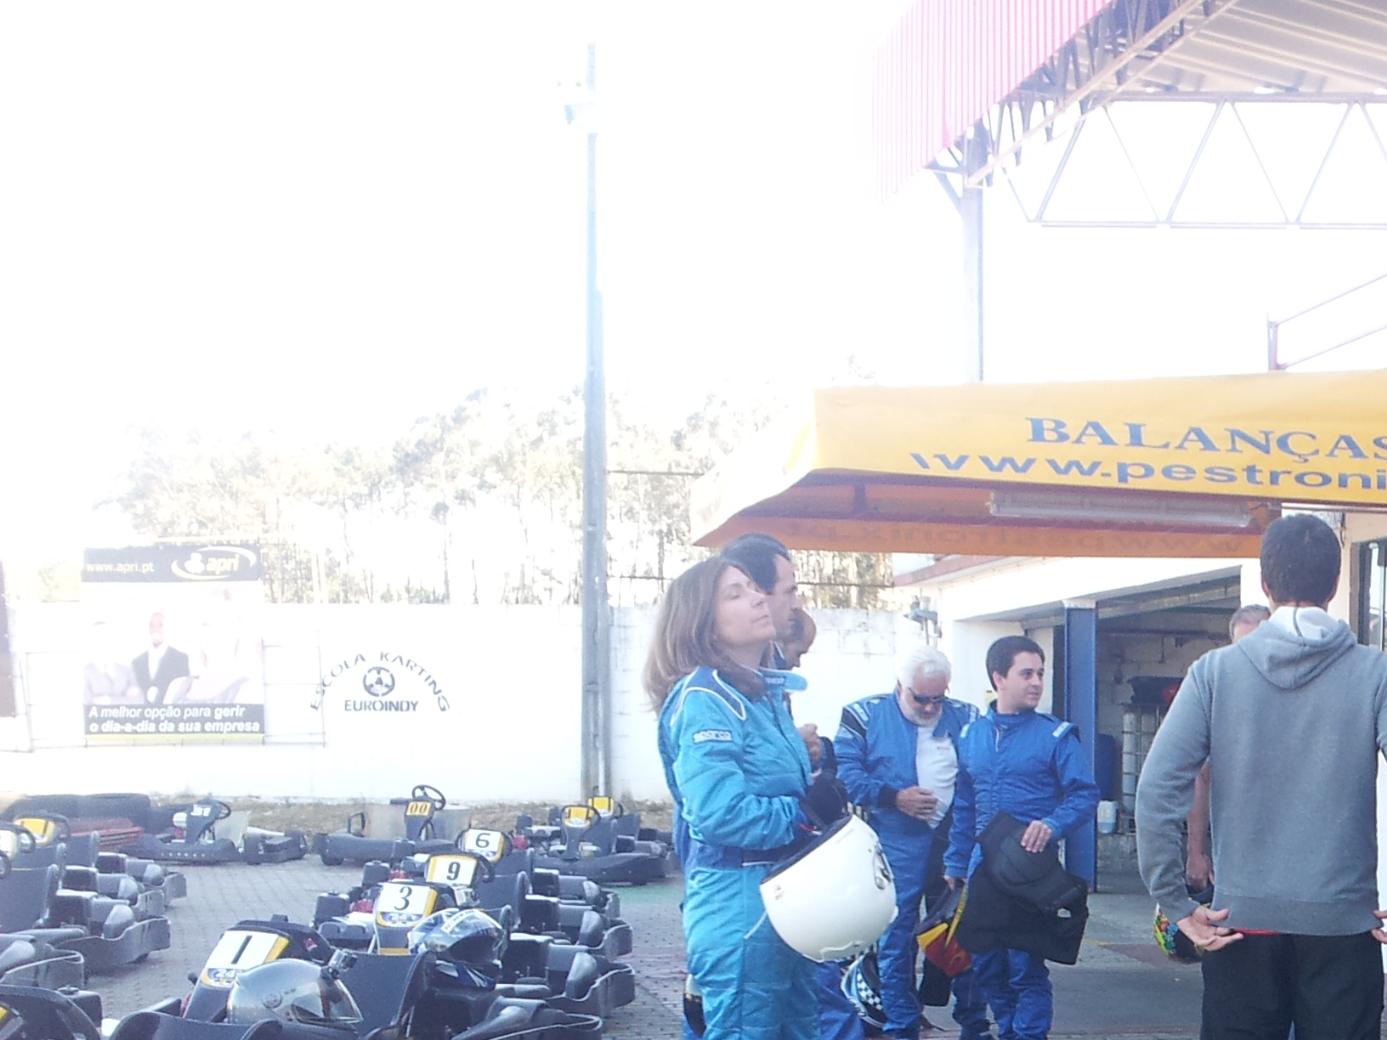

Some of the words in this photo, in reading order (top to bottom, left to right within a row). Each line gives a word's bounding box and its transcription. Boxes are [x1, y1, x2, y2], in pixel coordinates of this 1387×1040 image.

[86, 561, 155, 574] www.apri.pt
[206, 554, 241, 575] apri
[380, 651, 450, 712] KARTING
[89, 706, 98, 718] A
[101, 706, 142, 718] melhor
[144, 706, 181, 720] opção
[183, 707, 211, 719] para
[214, 705, 246, 719] gerir
[344, 699, 419, 712] EUROINDY
[89, 722, 99, 732] o
[101, 720, 155, 732] dia-a-dia
[158, 720, 175, 732] da
[178, 722, 201, 732] sua
[204, 722, 260, 734] empresa
[475, 832, 491, 848] 6
[446, 861, 461, 881] 9
[394, 886, 412, 911] 3
